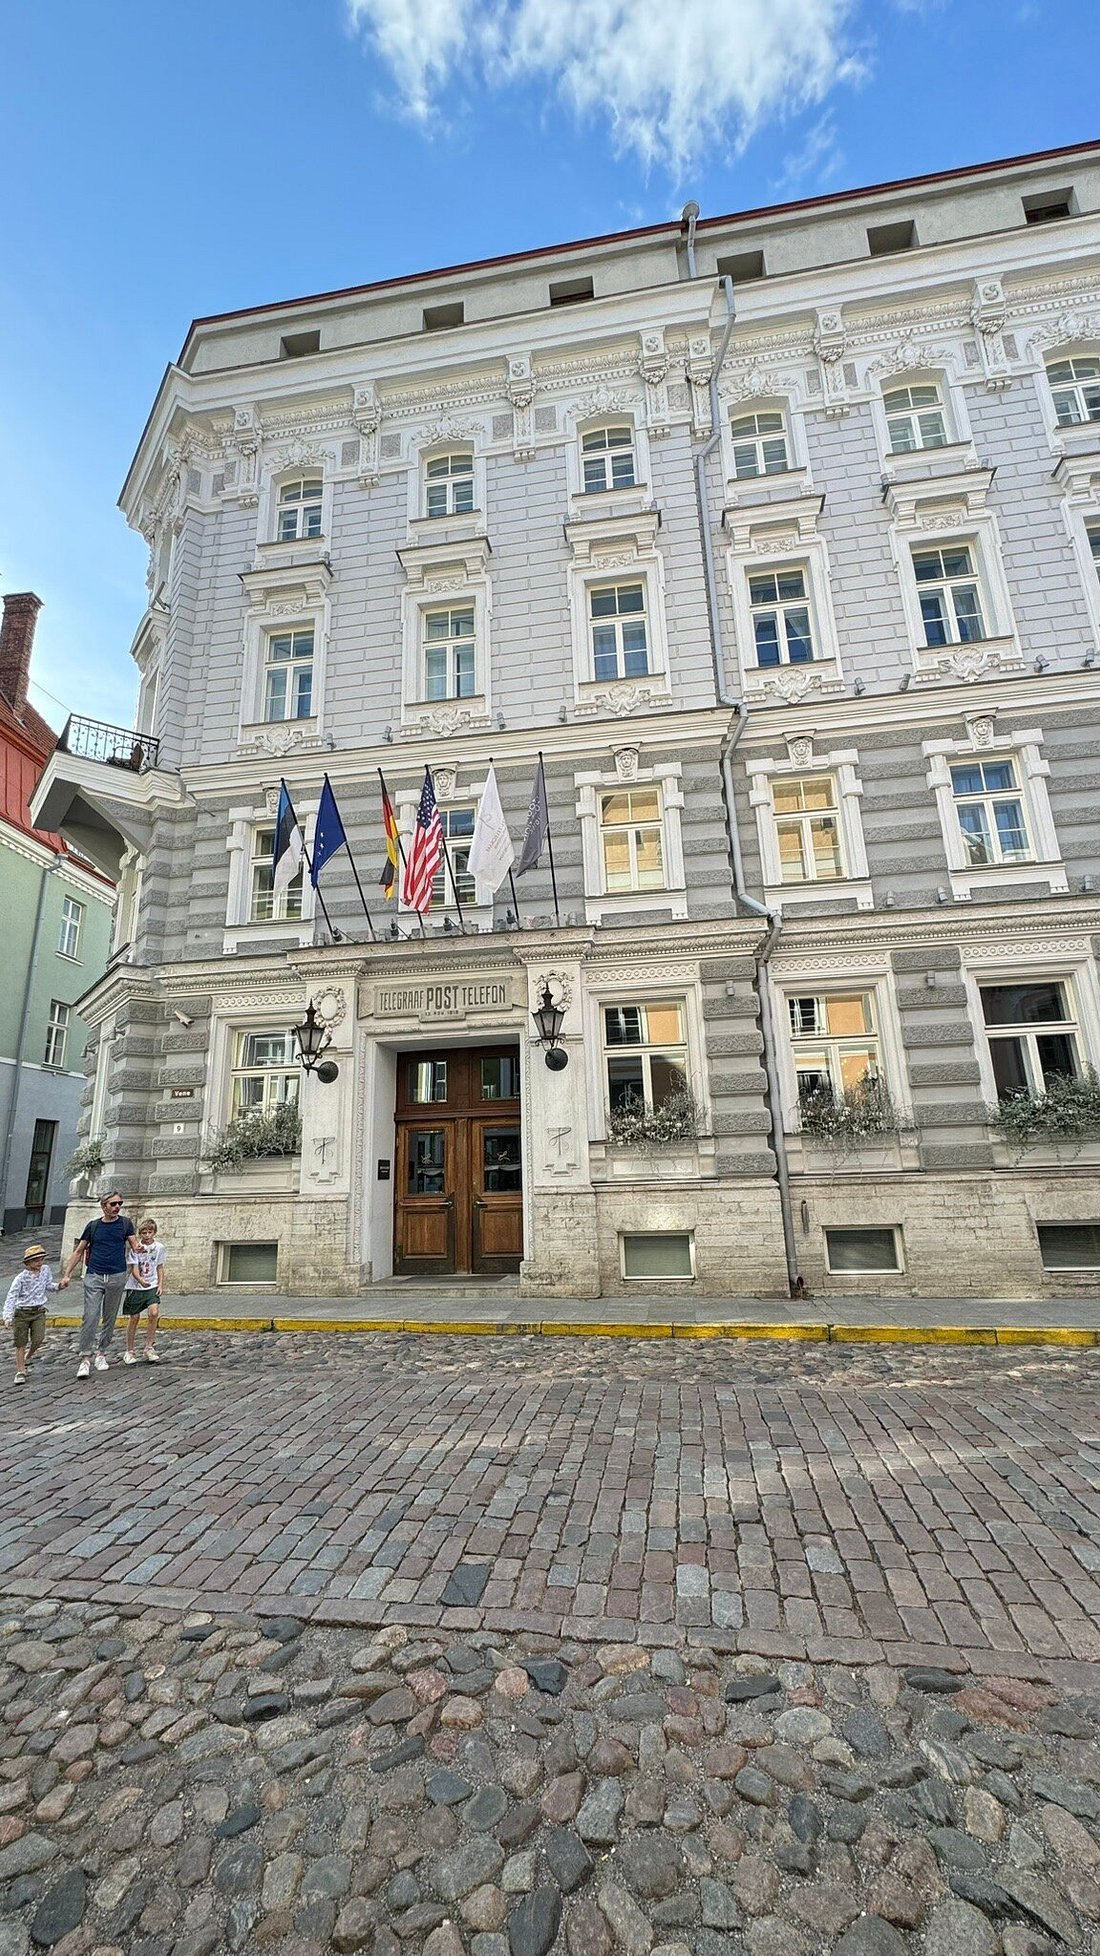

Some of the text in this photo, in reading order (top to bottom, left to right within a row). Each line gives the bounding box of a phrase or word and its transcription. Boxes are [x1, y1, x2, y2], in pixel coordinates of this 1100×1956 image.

[379, 984, 506, 1011] TELEGRAAF POST TELEFON
